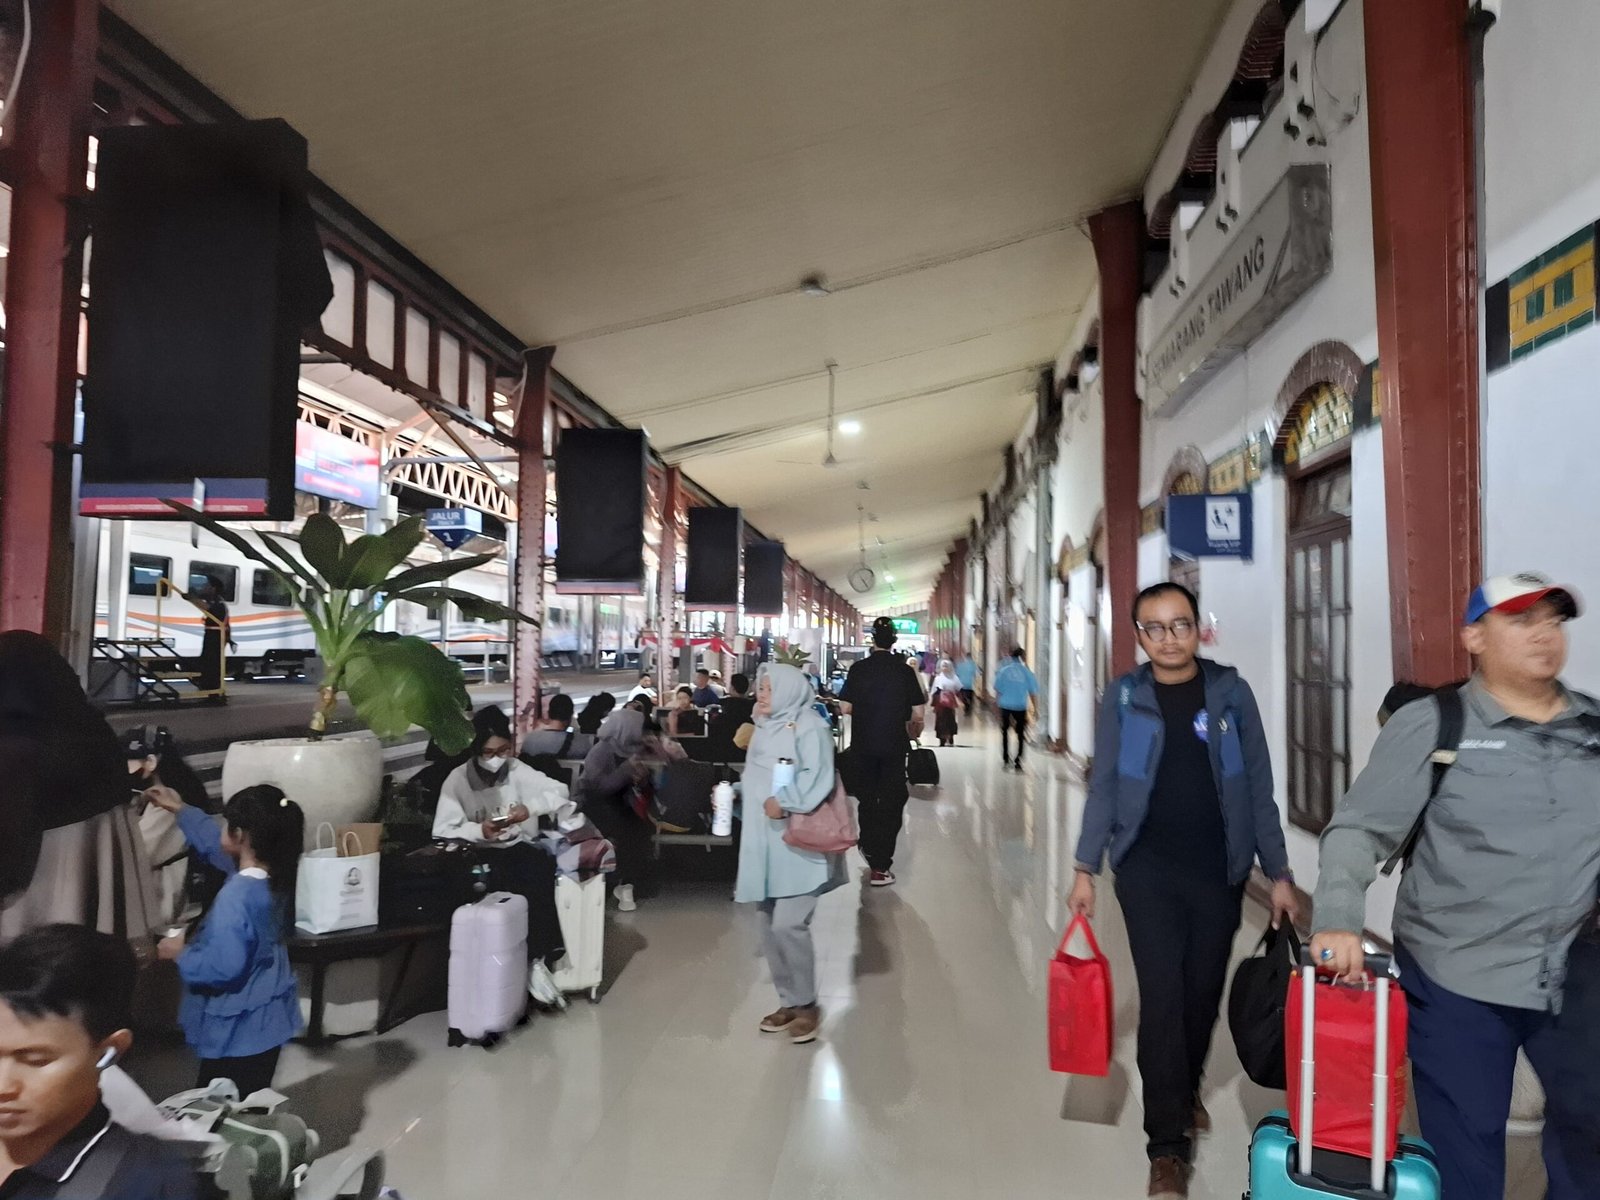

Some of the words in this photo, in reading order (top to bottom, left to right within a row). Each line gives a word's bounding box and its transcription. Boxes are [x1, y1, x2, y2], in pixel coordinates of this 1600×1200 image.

[1152, 304, 1206, 384] MARANG
[1207, 234, 1265, 324] TAWANG
[430, 511, 461, 521] JALUR
[442, 531, 454, 542] 1
